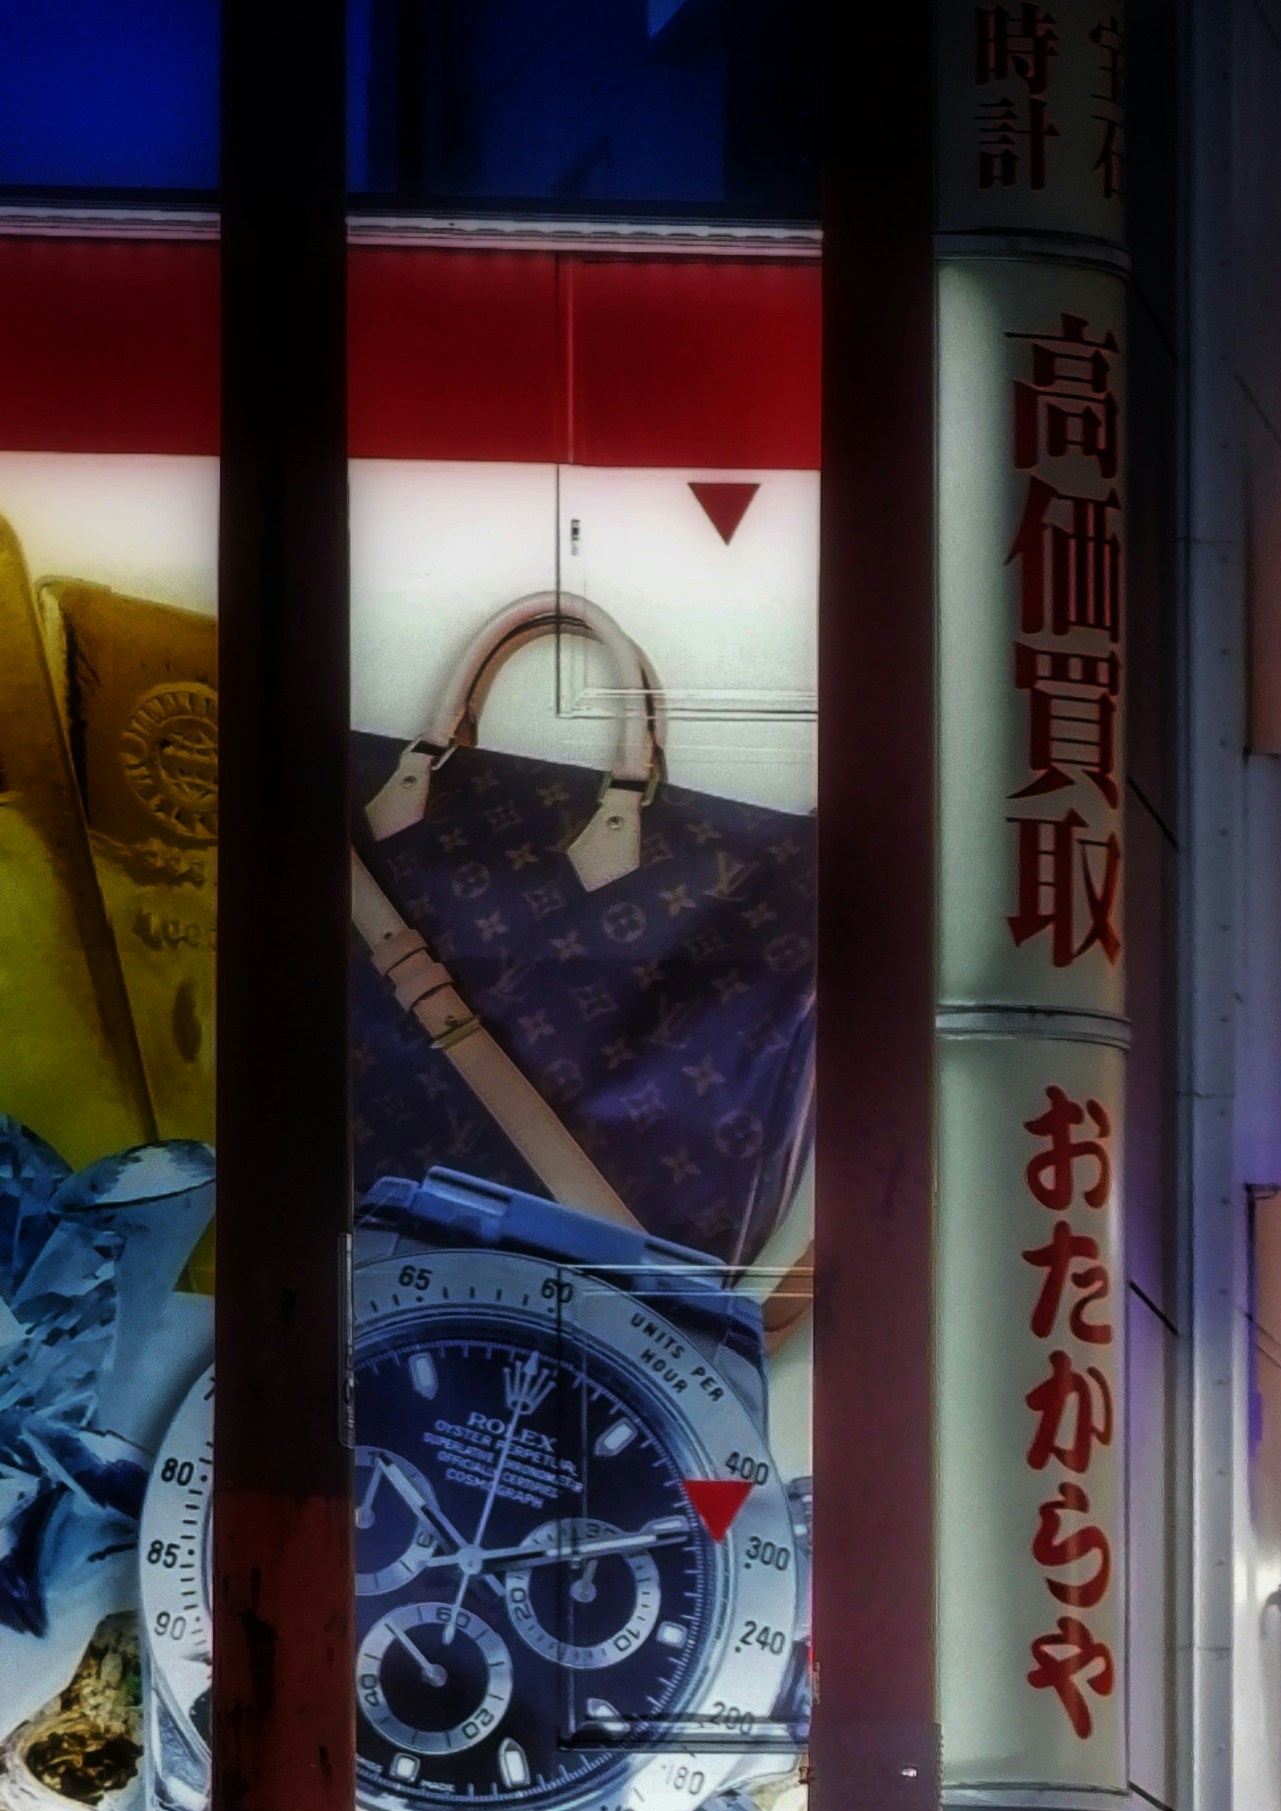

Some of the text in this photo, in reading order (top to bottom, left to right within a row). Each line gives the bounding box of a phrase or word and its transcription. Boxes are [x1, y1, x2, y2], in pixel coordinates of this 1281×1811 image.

[974, 3, 1061, 192] 時計
[1003, 314, 1121, 966] 高価買取
[397, 1264, 432, 1293] 65
[538, 1277, 573, 1304] 60
[630, 1311, 685, 1359] UNITS
[639, 1347, 689, 1395] HOUR
[467, 1411, 558, 1451] ROEX
[1021, 1084, 1114, 1741] おたからや
[161, 1457, 194, 1486] 80
[723, 1451, 769, 1488] 400
[147, 1539, 181, 1569] 85
[744, 1536, 789, 1571] 300
[153, 1611, 187, 1641] 90
[738, 1619, 784, 1656] 240
[664, 1762, 704, 1796] 180
